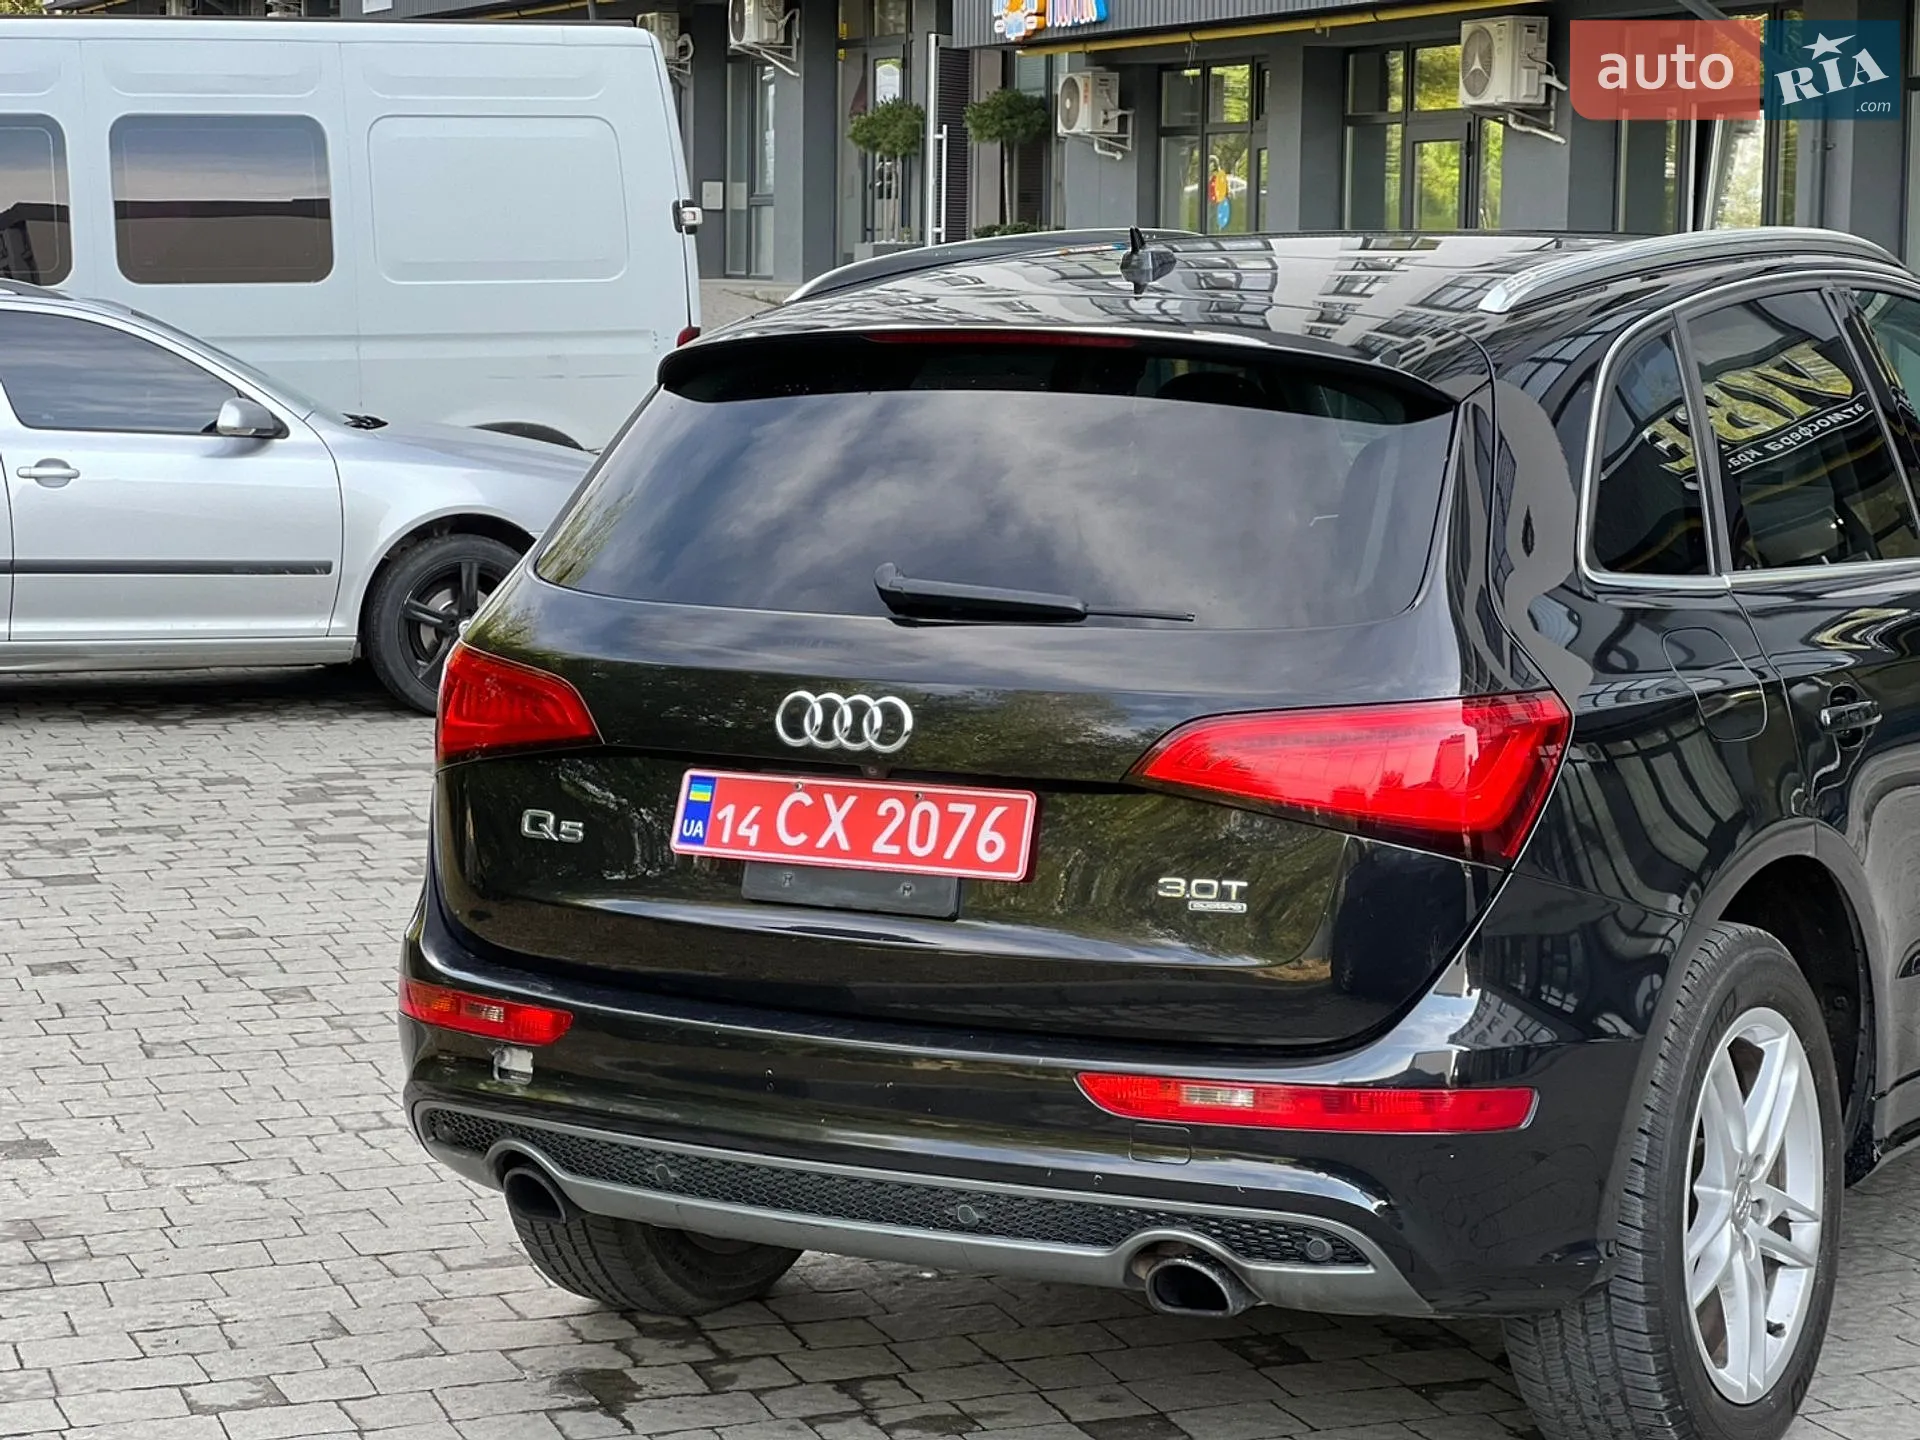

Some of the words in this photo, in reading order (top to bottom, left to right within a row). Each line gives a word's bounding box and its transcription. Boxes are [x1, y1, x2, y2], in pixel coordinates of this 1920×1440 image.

[521, 808, 585, 844] Q5
[682, 818, 705, 839] UA
[716, 803, 763, 848] 14
[776, 791, 859, 852] CX
[871, 797, 1009, 864] 2076
[1157, 877, 1249, 901] 3.0T
